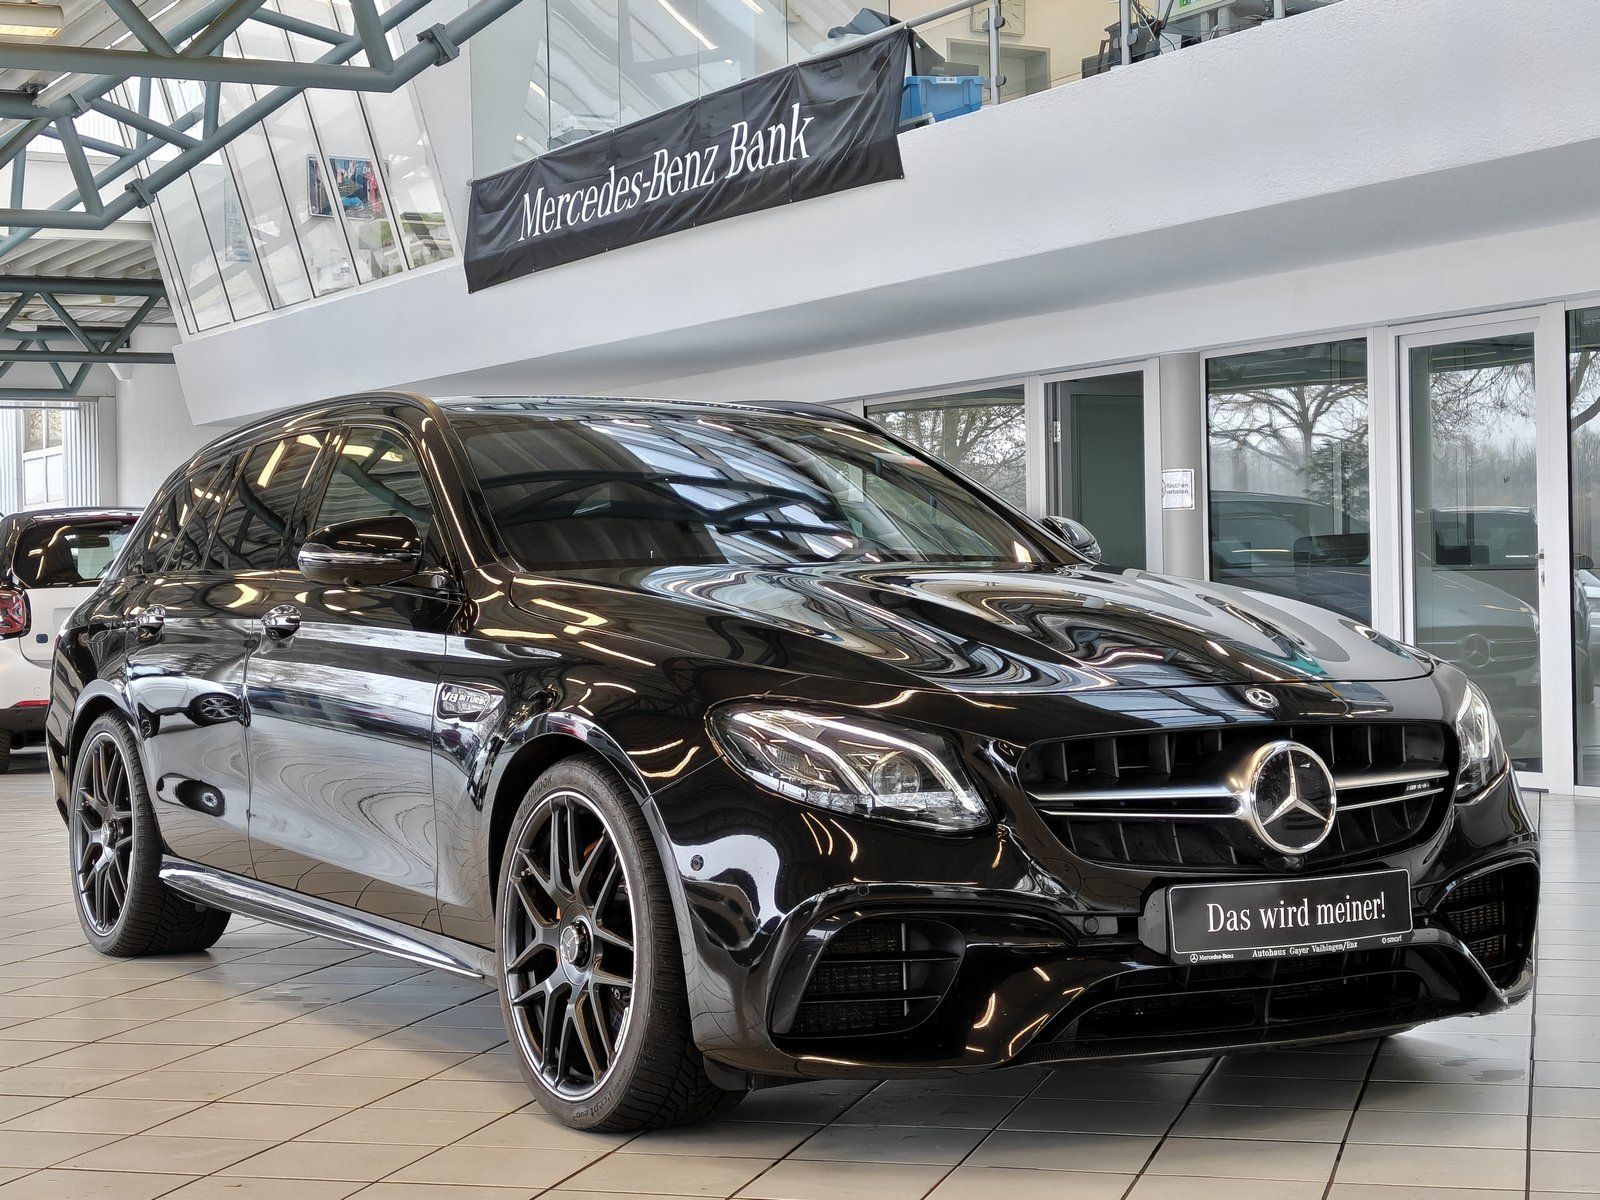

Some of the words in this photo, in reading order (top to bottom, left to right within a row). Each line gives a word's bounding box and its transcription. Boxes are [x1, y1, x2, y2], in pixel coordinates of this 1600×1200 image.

[517, 144, 720, 242] Mercedes-Benz
[724, 101, 815, 179] Bank
[441, 690, 459, 703] V8
[1206, 902, 1251, 933] Das
[1258, 897, 1309, 930] wird
[1315, 891, 1387, 926] meiner!
[1199, 953, 1234, 961] Mercedes-Benz
[1252, 949, 1287, 958] Autohaus
[1289, 946, 1310, 956] Gayer
[1311, 941, 1359, 953] Vaihingen/Enz
